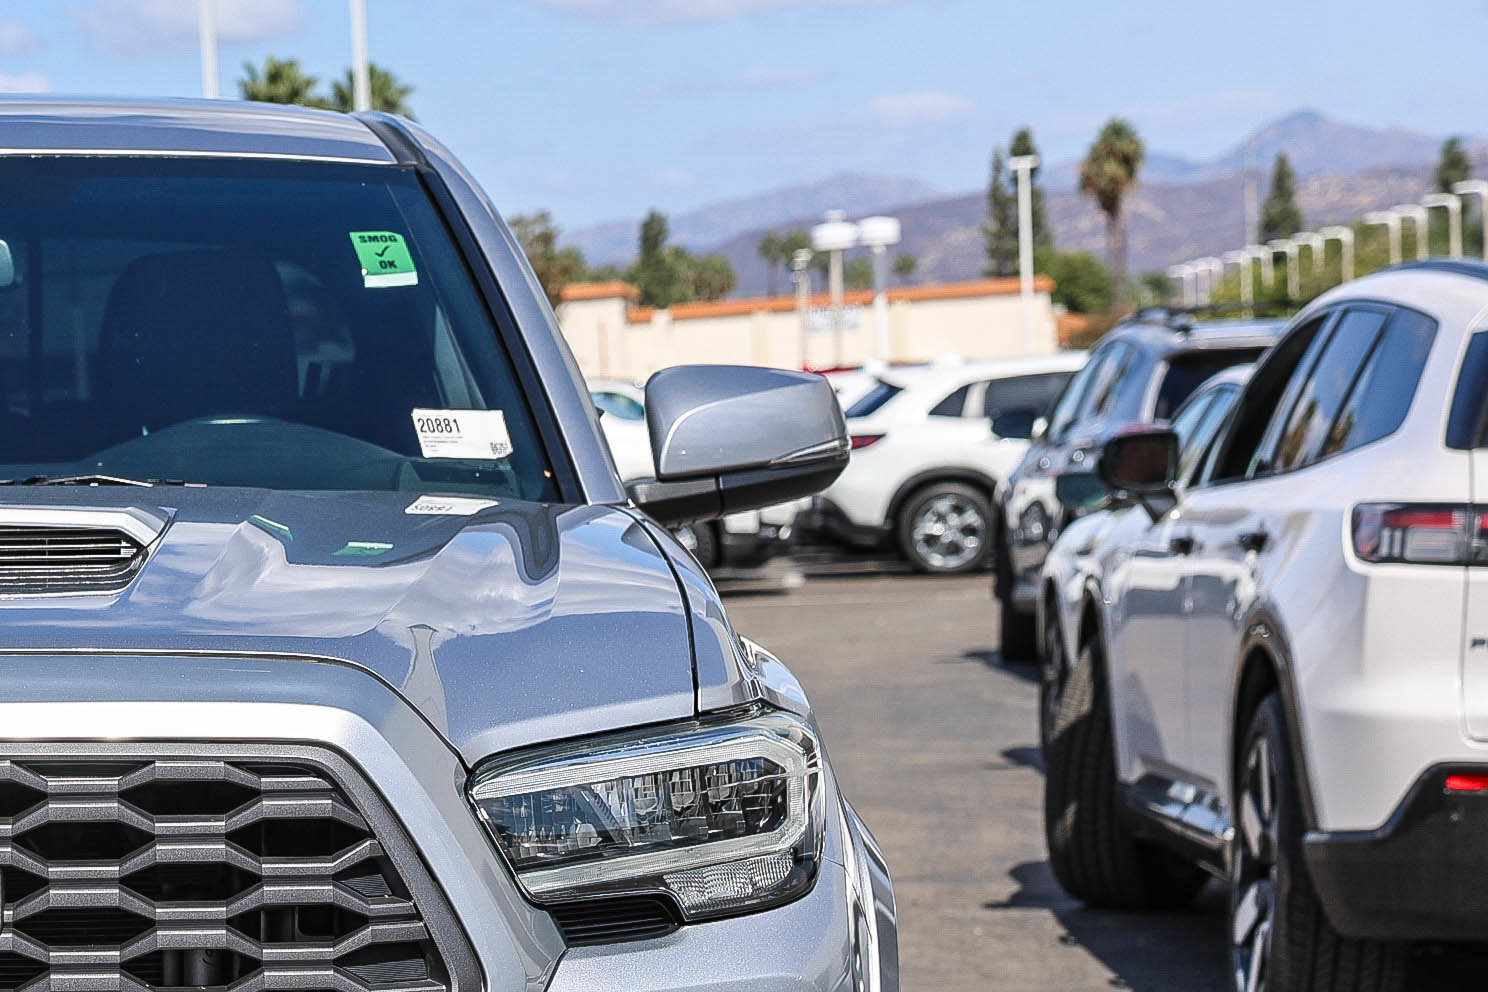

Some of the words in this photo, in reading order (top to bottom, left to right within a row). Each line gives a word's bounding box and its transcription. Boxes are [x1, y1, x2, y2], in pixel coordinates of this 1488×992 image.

[358, 234, 398, 244] SMOG
[378, 260, 398, 270] OK
[417, 417, 461, 434] 20881
